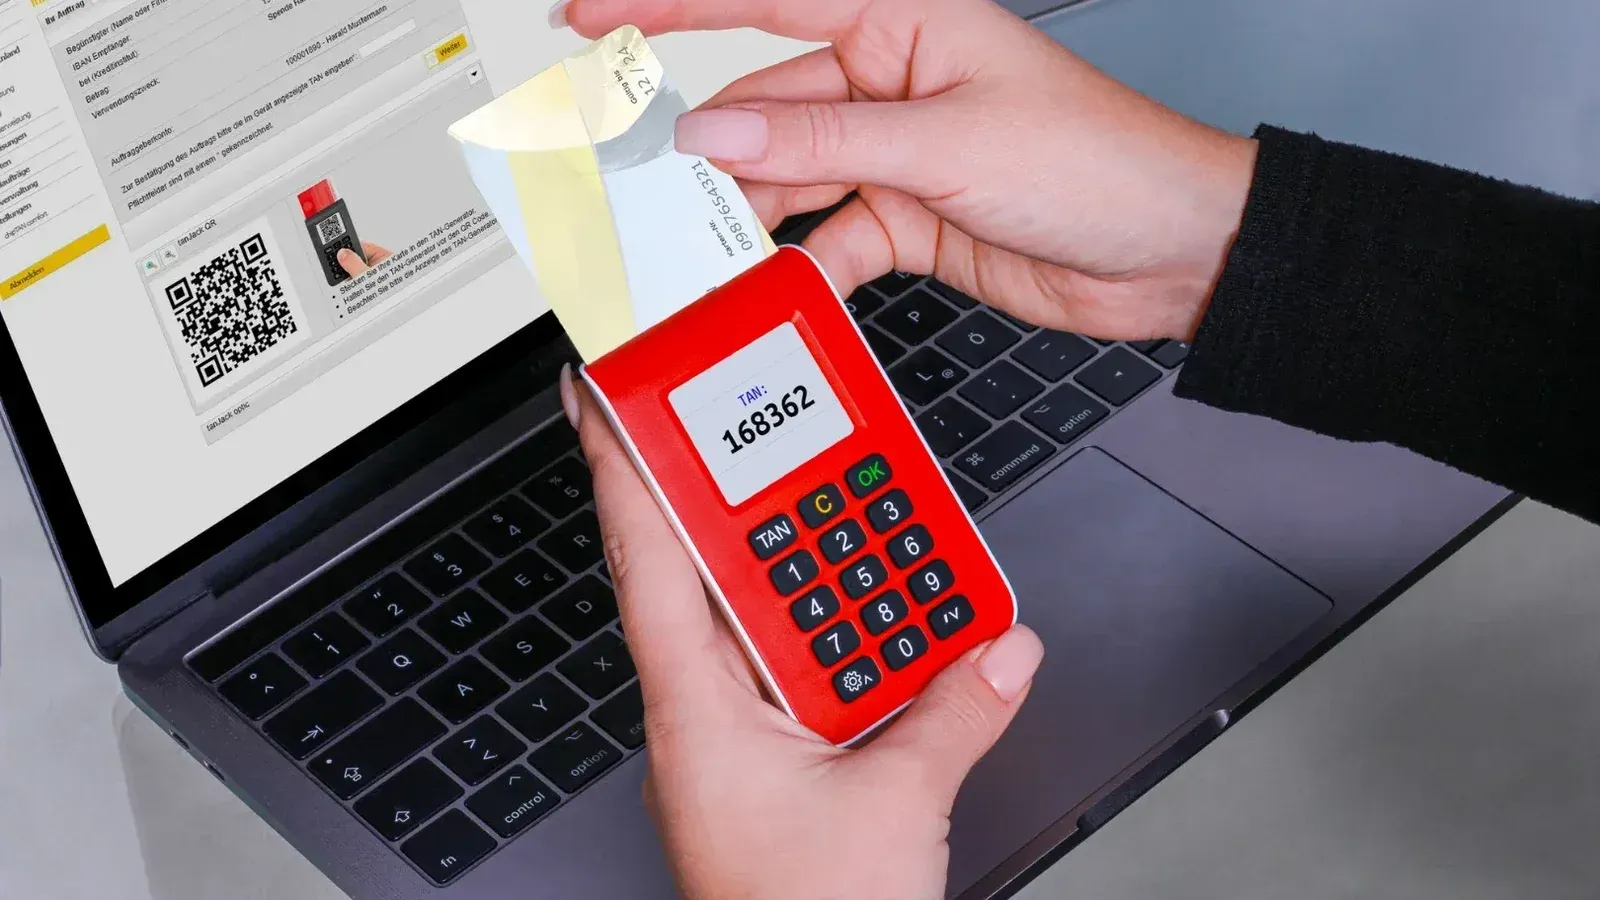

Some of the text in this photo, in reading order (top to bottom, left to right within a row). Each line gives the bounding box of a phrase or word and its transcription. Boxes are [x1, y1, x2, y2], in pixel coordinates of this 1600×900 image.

[45, 15, 55, 25] Ihr
[57, 1, 85, 19] Auftrag
[268, 3, 293, 21] Spende
[66, 26, 109, 55] Begünstigter
[110, 14, 133, 32] (Name
[135, 4, 150, 18] oder
[285, 41, 322, 67] 100001890
[325, 27, 348, 44] Harald
[348, 5, 388, 31] Mustermann
[72, 35, 132, 71] IBAN Empfänger:
[617, 46, 637, 65] 24
[85, 85, 110, 104] Betrag:
[613, 69, 638, 104] Gültig bis
[638, 76, 656, 96] 12
[91, 77, 160, 119] Verwendungszweck:
[120, 181, 134, 194] Zur
[134, 158, 175, 187] Bestätigung
[175, 151, 188, 164] des
[189, 133, 217, 155] Auftrags
[216, 125, 232, 139] bitte
[232, 118, 244, 130] die
[253, 101, 273, 118] Gerät
[273, 81, 309, 106] angezeigte
[308, 73, 324, 87] TAN
[110, 125, 175, 166] Auftraggeberkonto:
[127, 184, 168, 210] Pflichtfelder
[168, 173, 183, 188] sind
[183, 167, 195, 179] mit
[195, 155, 217, 173] einem
[221, 121, 274, 158] gekennzeichnet.
[691, 160, 753, 251] 0987654321
[177, 219, 217, 247] tanJack QR
[709, 219, 735, 258] Karten-Nr.
[340, 275, 366, 295] Stecken
[366, 268, 378, 279] Sie
[377, 260, 391, 271] Ihre
[391, 249, 409, 263] Karte
[409, 244, 416, 252] in
[416, 237, 429, 248] den
[343, 288, 365, 305] Halten
[364, 281, 377, 291] Sie
[376, 273, 390, 284] den
[389, 244, 436, 276] TAN-Generator
[436, 237, 447, 247] vor
[447, 229, 460, 240] den
[460, 221, 472, 232] QR
[9, 265, 45, 290] Abmelden
[347, 292, 378, 314] Beachten
[377, 285, 389, 295] Sie
[389, 276, 404, 288] bitte
[404, 269, 414, 279] die
[415, 253, 440, 273] Anzeige
[440, 246, 453, 257] des
[907, 310, 920, 323] P
[967, 330, 985, 345] Ö
[916, 370, 933, 381] L
[941, 368, 955, 379] @
[737, 385, 768, 407] TAN:
[206, 401, 250, 432] tanJack optic
[722, 385, 815, 454] 168362
[1059, 407, 1092, 434] option
[990, 443, 1041, 482] command
[857, 461, 886, 487] OK
[564, 486, 579, 498] 5
[814, 494, 833, 514] C
[883, 501, 899, 521] 3
[509, 524, 522, 536] 4
[572, 534, 590, 547] R
[755, 520, 791, 549] TAN
[835, 531, 853, 552] 2
[904, 536, 920, 556] 6
[447, 564, 463, 577] 3
[514, 573, 532, 587] E
[788, 562, 802, 582] 1
[856, 566, 873, 587] 5
[924, 571, 940, 591] 9
[387, 603, 404, 617] 2
[575, 600, 593, 614] D
[810, 597, 825, 618] 4
[878, 602, 894, 623] 8
[450, 611, 473, 629] W
[313, 632, 323, 642] !
[516, 640, 534, 654] S
[826, 632, 842, 654] 7
[898, 637, 913, 658] 0
[327, 644, 340, 655] 1
[393, 654, 413, 668] Q
[593, 656, 613, 672] X
[457, 682, 474, 697] A
[532, 698, 548, 713] Y
[569, 748, 608, 778] option
[504, 791, 546, 825] control
[440, 854, 457, 868] fn
